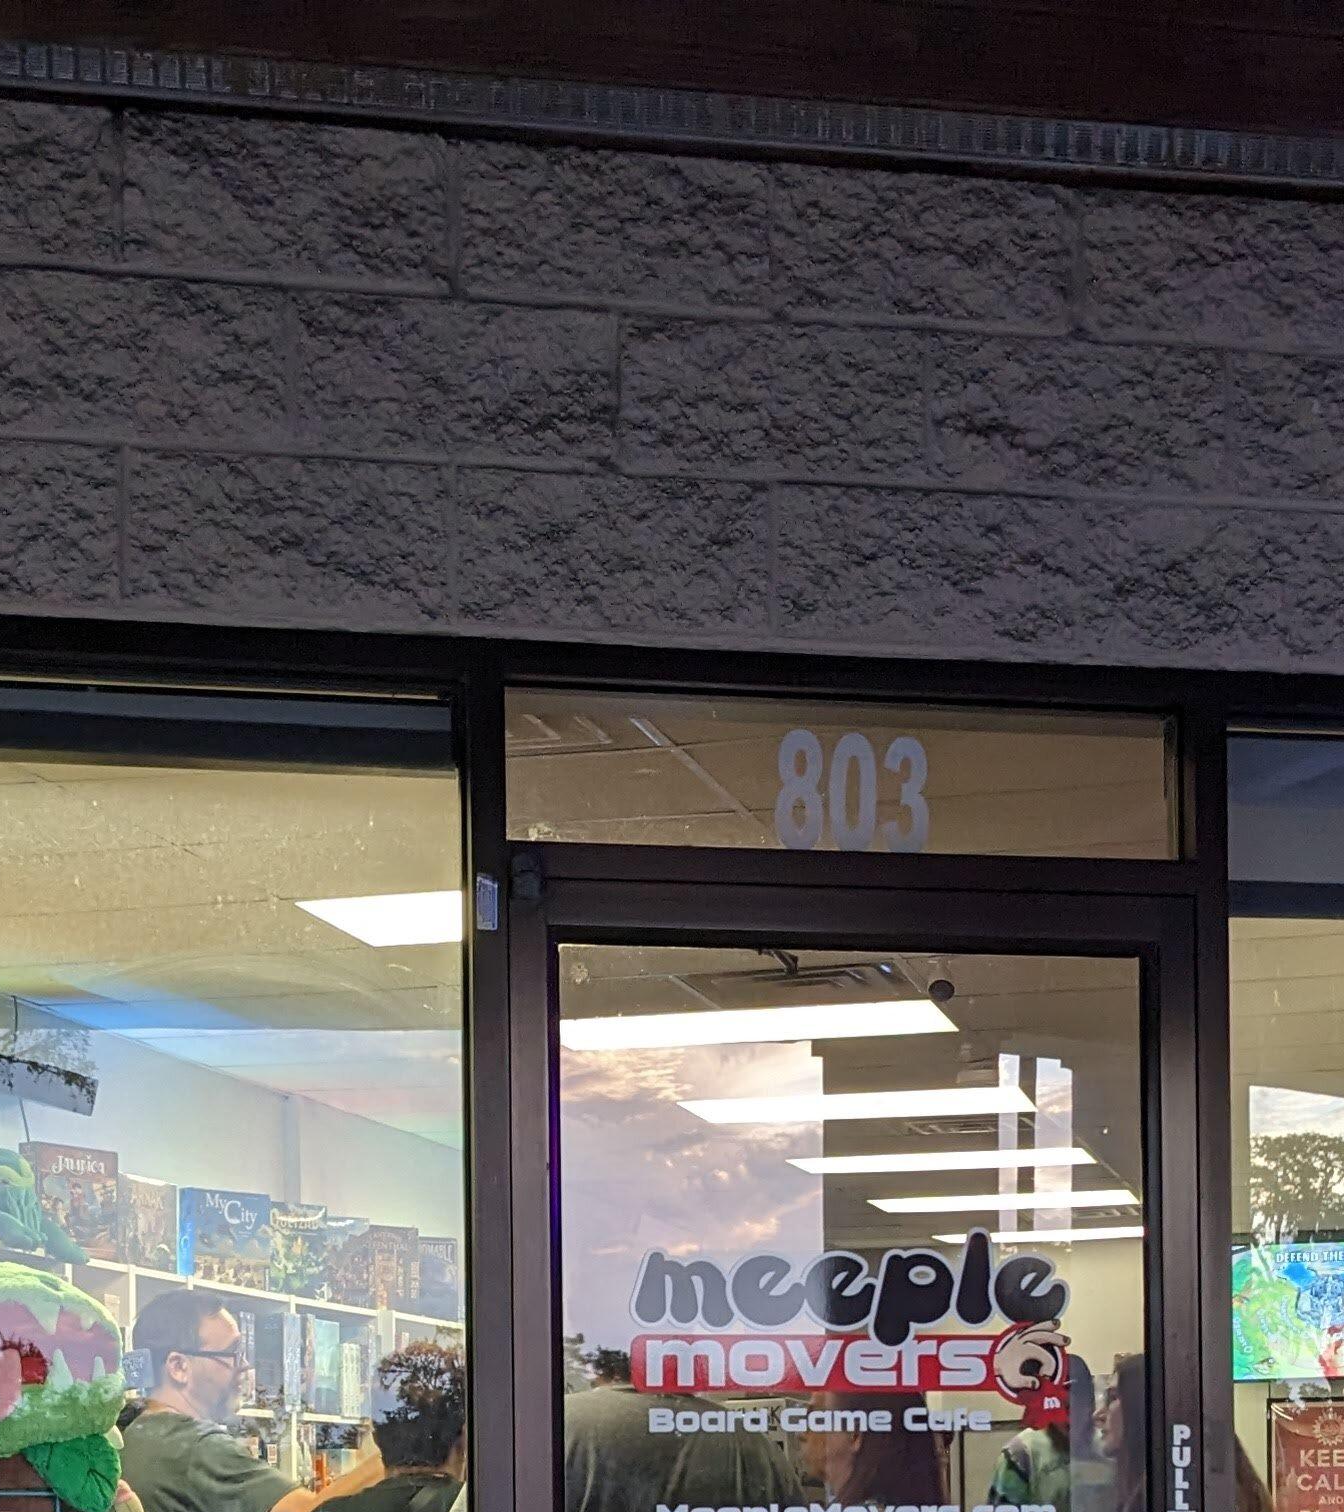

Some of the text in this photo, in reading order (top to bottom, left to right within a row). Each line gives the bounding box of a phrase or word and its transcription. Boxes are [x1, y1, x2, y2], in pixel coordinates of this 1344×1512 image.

[774, 728, 931, 854] 803
[205, 1192, 258, 1230] My City
[1276, 1252, 1319, 1263] DEFEND
[1323, 1250, 1344, 1261] THE
[630, 1227, 1070, 1347] meeple
[645, 1338, 989, 1389] movers
[648, 1406, 991, 1434] Board Game Cafe
[1171, 1424, 1192, 1510] PULL
[1318, 1495, 1344, 1505] AND
